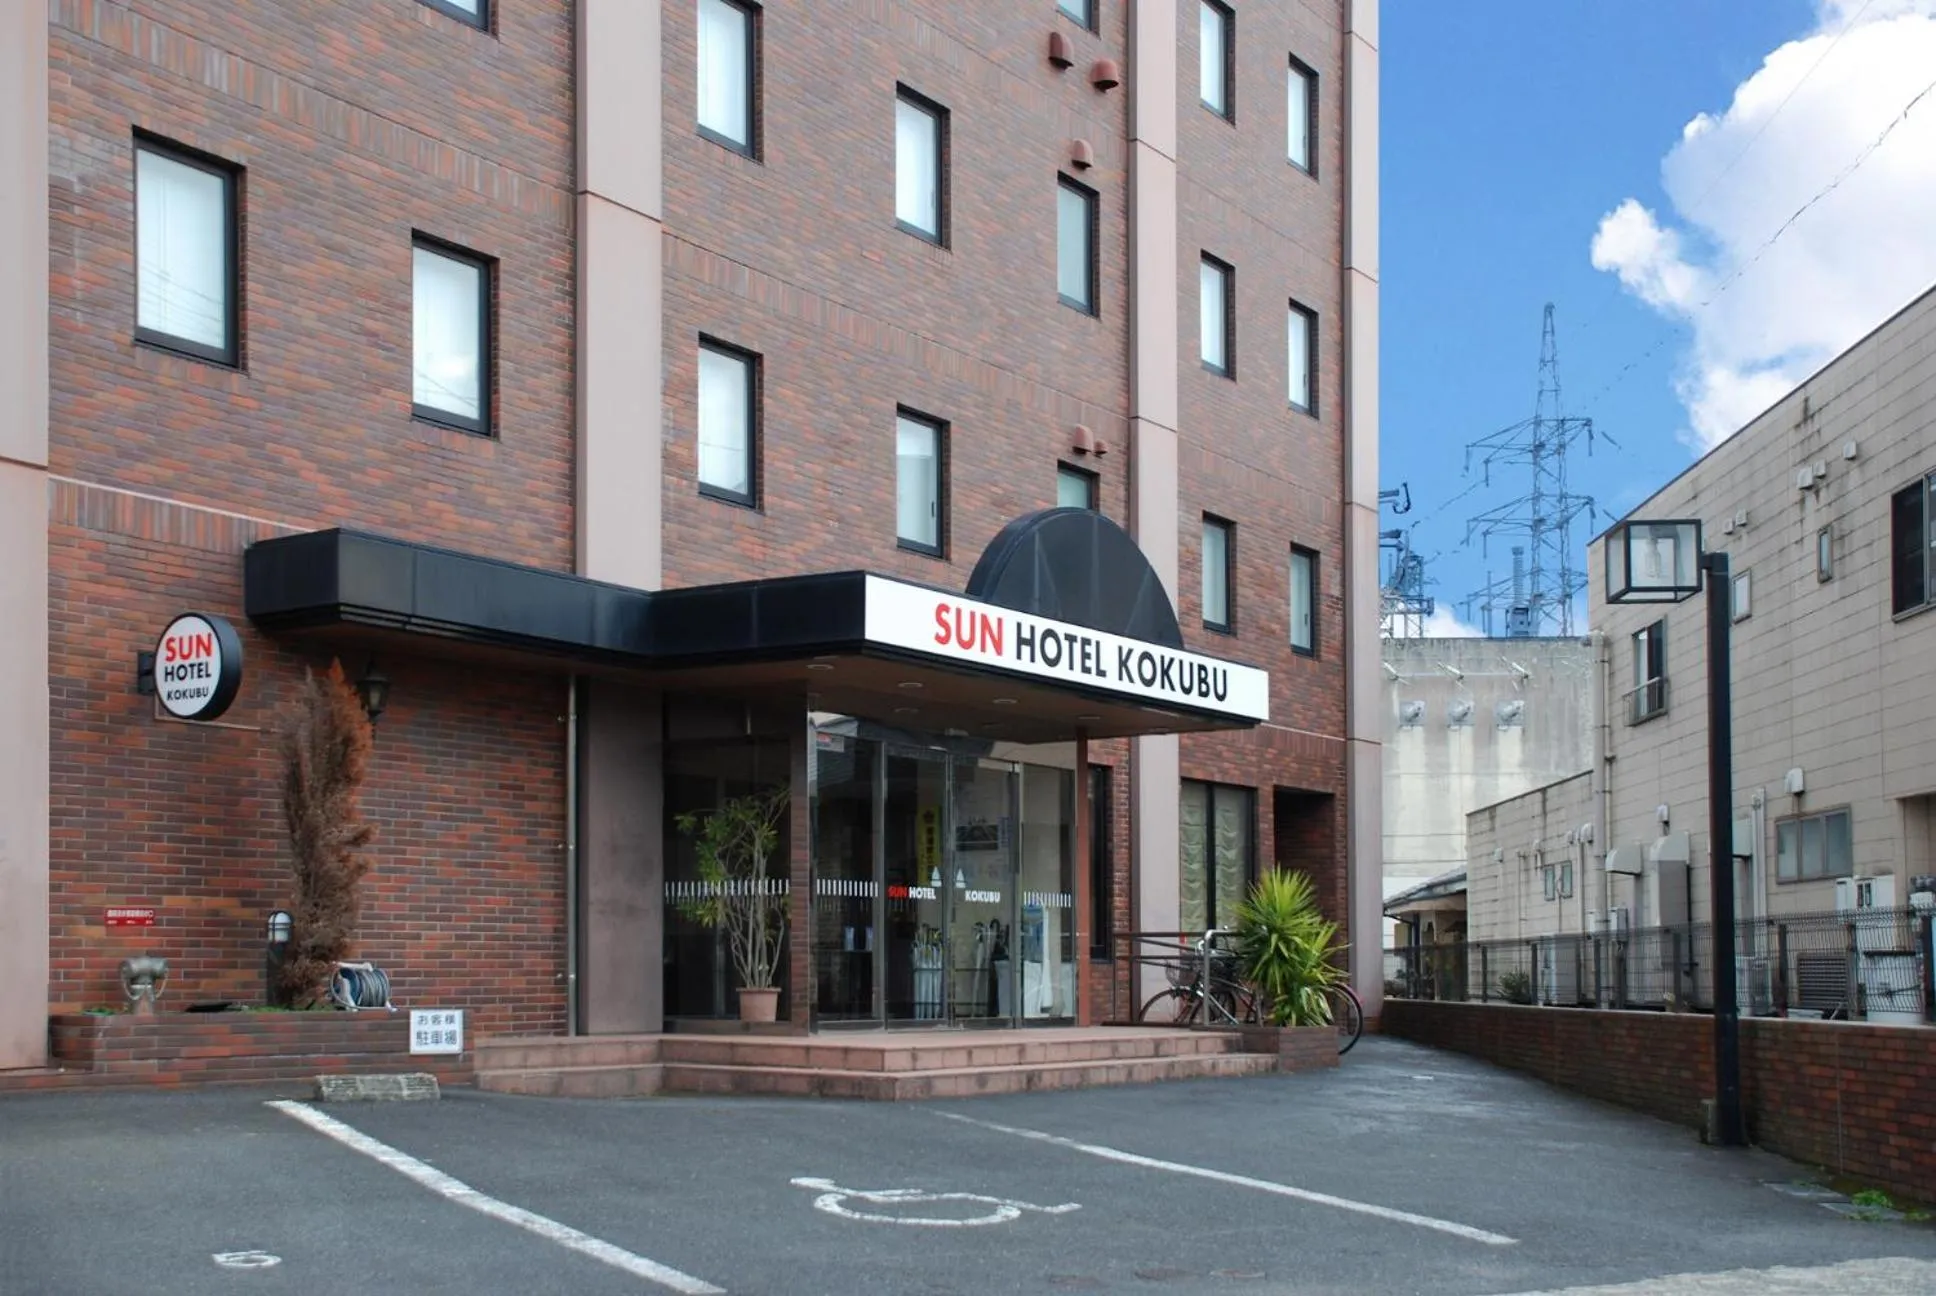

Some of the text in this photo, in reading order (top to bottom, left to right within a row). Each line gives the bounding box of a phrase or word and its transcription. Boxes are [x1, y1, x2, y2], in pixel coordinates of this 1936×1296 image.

[165, 632, 212, 662] SUN
[935, 603, 1228, 702] SUN HOTEL KOKUBU
[164, 662, 212, 682] HOTEL
[167, 686, 209, 701] KOKUBU
[888, 885, 936, 900] SUN HOTEL
[965, 890, 1001, 903] KOKUBU
[417, 1014, 456, 1026] お客様
[416, 1030, 458, 1046] 駐車場
